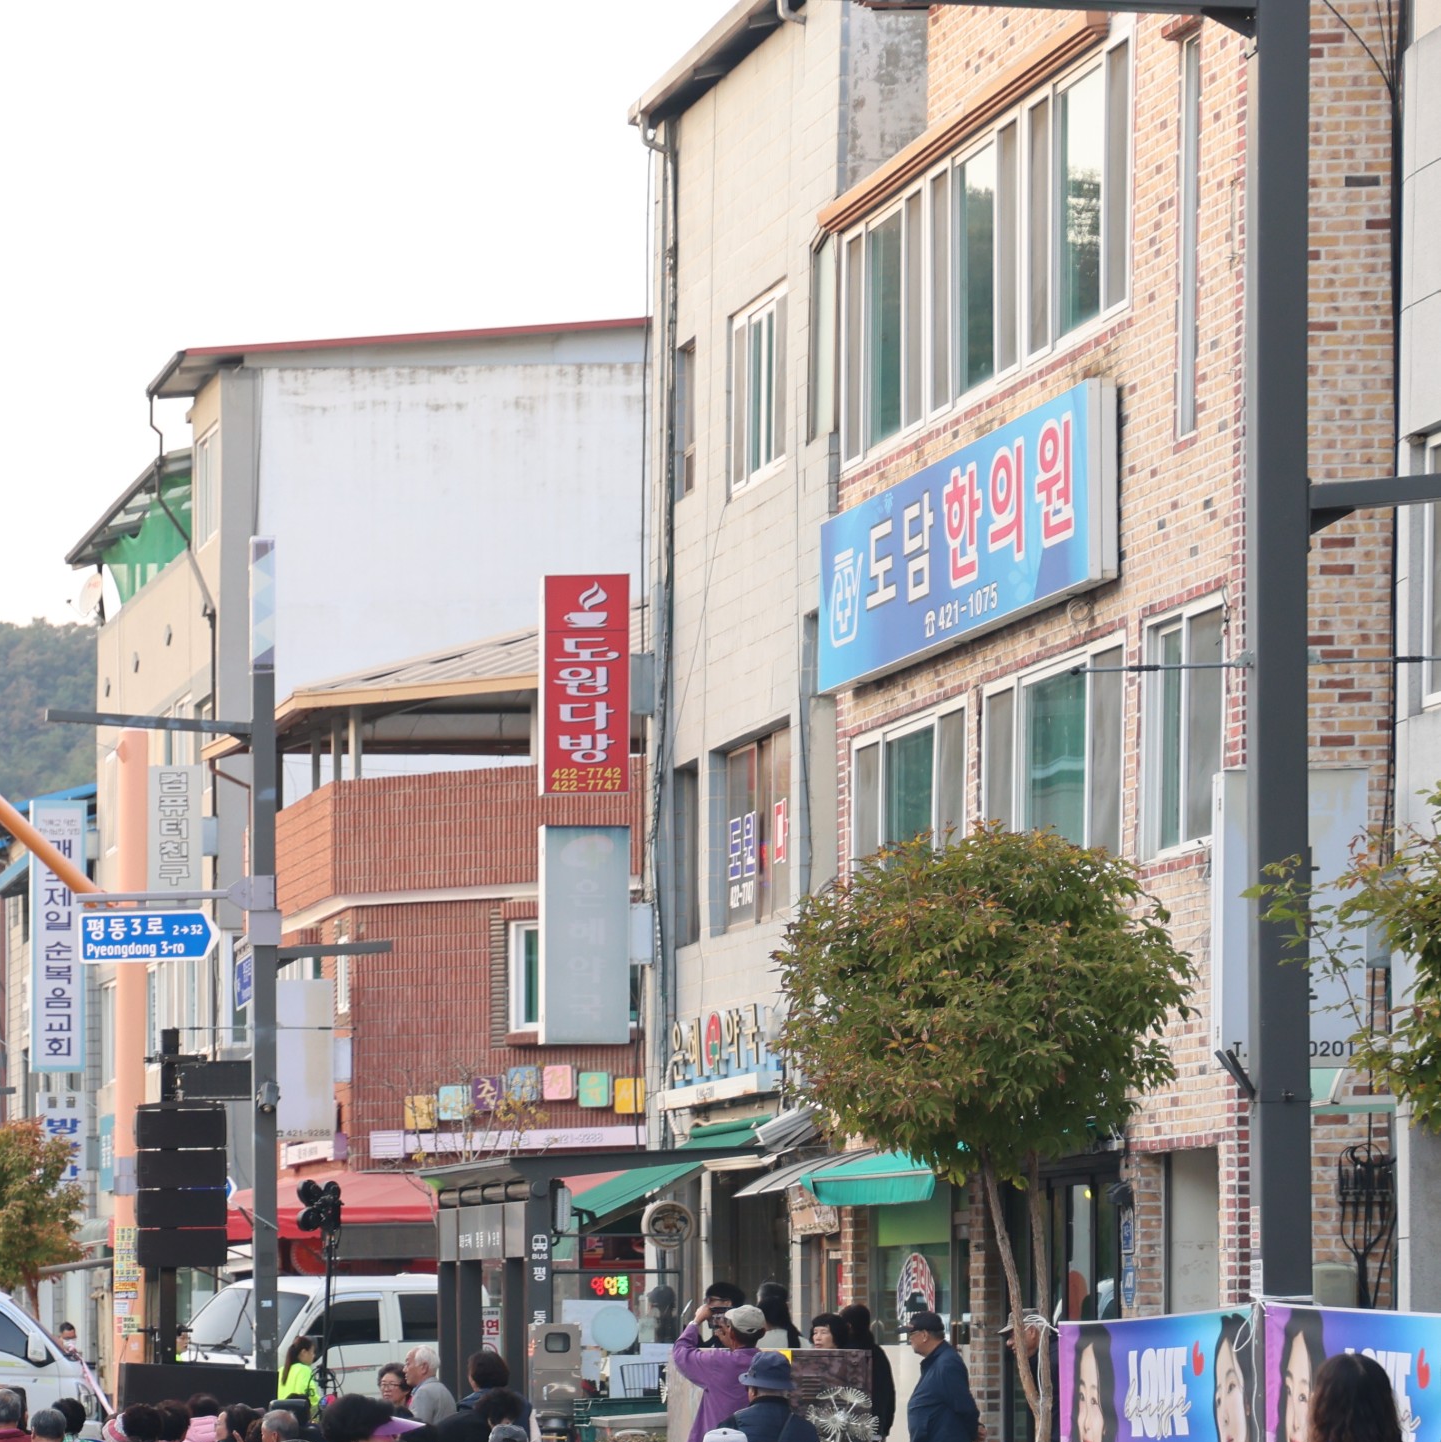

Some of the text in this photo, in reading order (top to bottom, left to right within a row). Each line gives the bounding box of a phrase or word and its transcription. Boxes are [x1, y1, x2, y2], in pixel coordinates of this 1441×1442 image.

[938, 582, 998, 631] 421-1075
[552, 637, 619, 763] 도원다방
[551, 768, 622, 779] 422-7742
[551, 780, 622, 791] 422-7747
[159, 772, 190, 886] 컴퓨터친구
[728, 811, 756, 881] 도원
[86, 917, 166, 940] 평동3로
[86, 941, 185, 958] Pyeongdong 3-ro
[44, 940, 73, 1057] 순복음교회
[591, 1275, 630, 1296] 영업중
[481, 1319, 500, 1336] 연
[1127, 1346, 1190, 1438] LOVE
